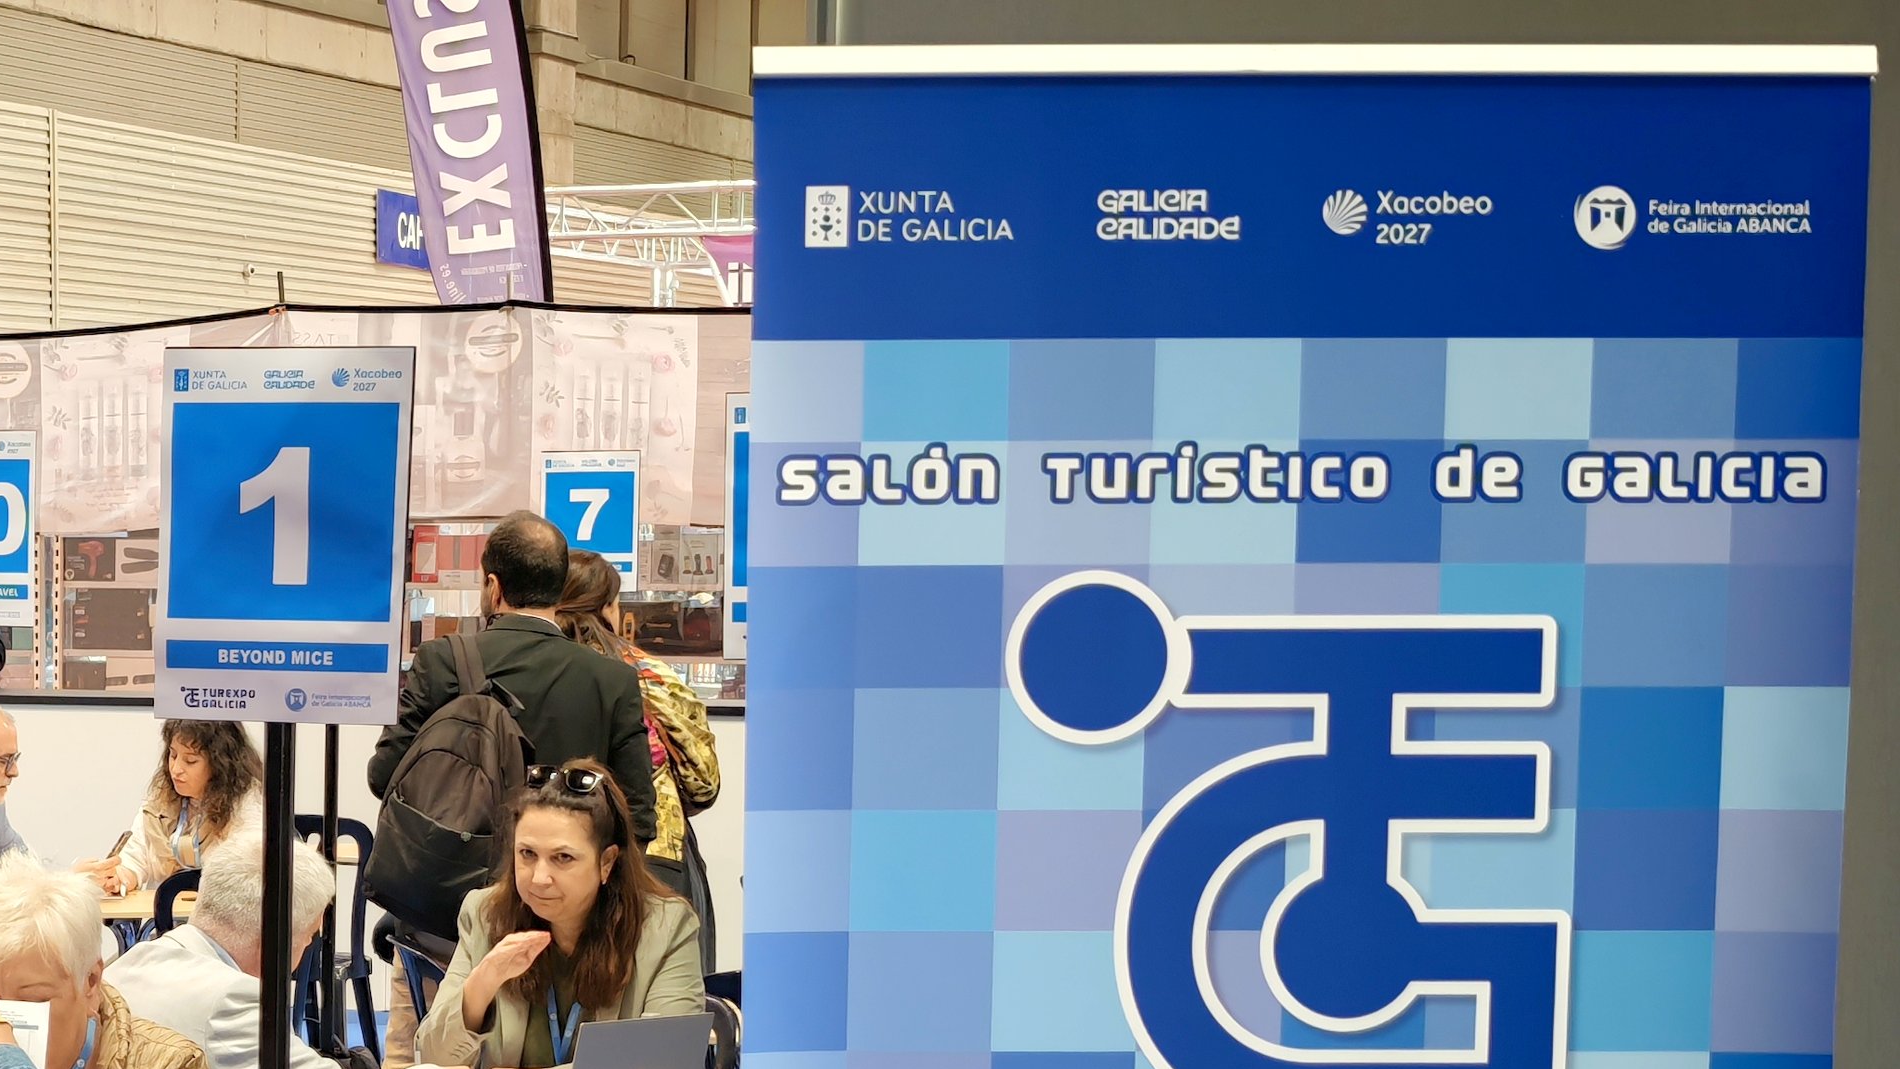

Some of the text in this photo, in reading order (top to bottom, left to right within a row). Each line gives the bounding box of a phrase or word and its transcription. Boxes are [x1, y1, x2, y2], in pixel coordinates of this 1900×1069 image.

[858, 190, 954, 214] XUNTA
[1097, 189, 1208, 212] GALICIA
[1376, 190, 1494, 215] Xacobeo
[1648, 199, 1811, 216] Feira Internacional
[857, 218, 1014, 242] DE GALICIA
[1096, 215, 1242, 241] CALIDADE
[1376, 224, 1432, 245] 2027
[1647, 218, 1812, 235] de Galicia ABANCA
[193, 370, 227, 379] XUNTA
[353, 368, 403, 379] Xacobeo
[192, 381, 248, 390] DE GALICIA
[353, 382, 376, 391] 2027
[1433, 445, 1522, 501] de
[239, 446, 310, 586] 1
[569, 488, 610, 541] 7
[218, 649, 333, 666] BEYOND MICE
[203, 688, 255, 698] TUREXPO
[202, 699, 246, 709] GALICIA
